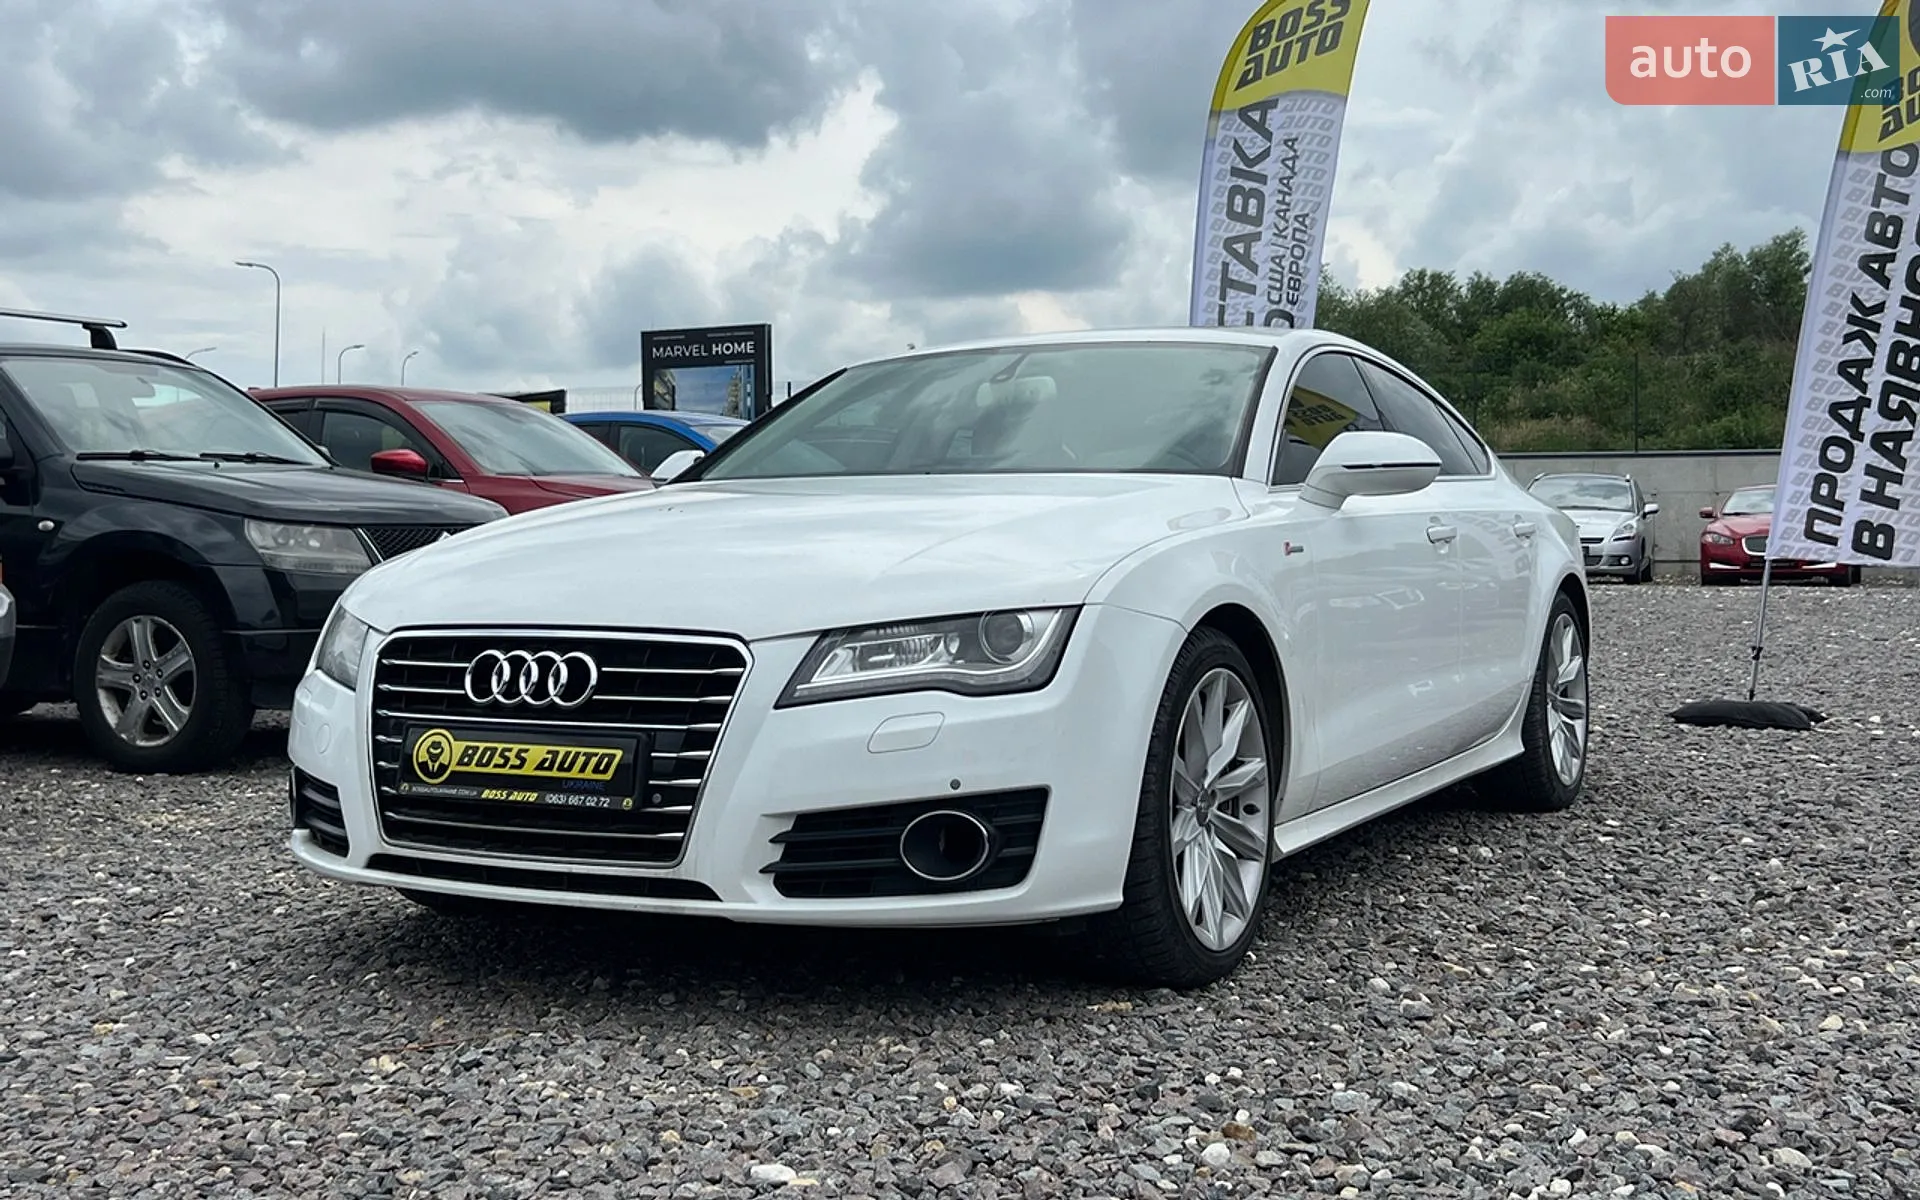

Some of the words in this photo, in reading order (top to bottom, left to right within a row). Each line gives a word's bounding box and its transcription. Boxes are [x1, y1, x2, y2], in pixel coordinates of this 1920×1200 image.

[1248, 0, 1351, 56] BOSS
[1234, 21, 1343, 91] AUTO
[1272, 137, 1299, 240] КАНАДА
[1267, 254, 1285, 305] США
[1286, 213, 1309, 306] ЄВРОПА
[652, 344, 709, 359] MARVEL
[712, 341, 756, 356] HOME
[1803, 290, 1886, 547] ПРОДАЖ
[1858, 143, 1919, 291] АВТО
[1851, 519, 1895, 561] В
[455, 744, 530, 770] BOSS
[533, 749, 617, 775] AUTO
[480, 788, 508, 800] BOSS
[508, 791, 538, 803] AUTO
[598, 797, 610, 808] 72
